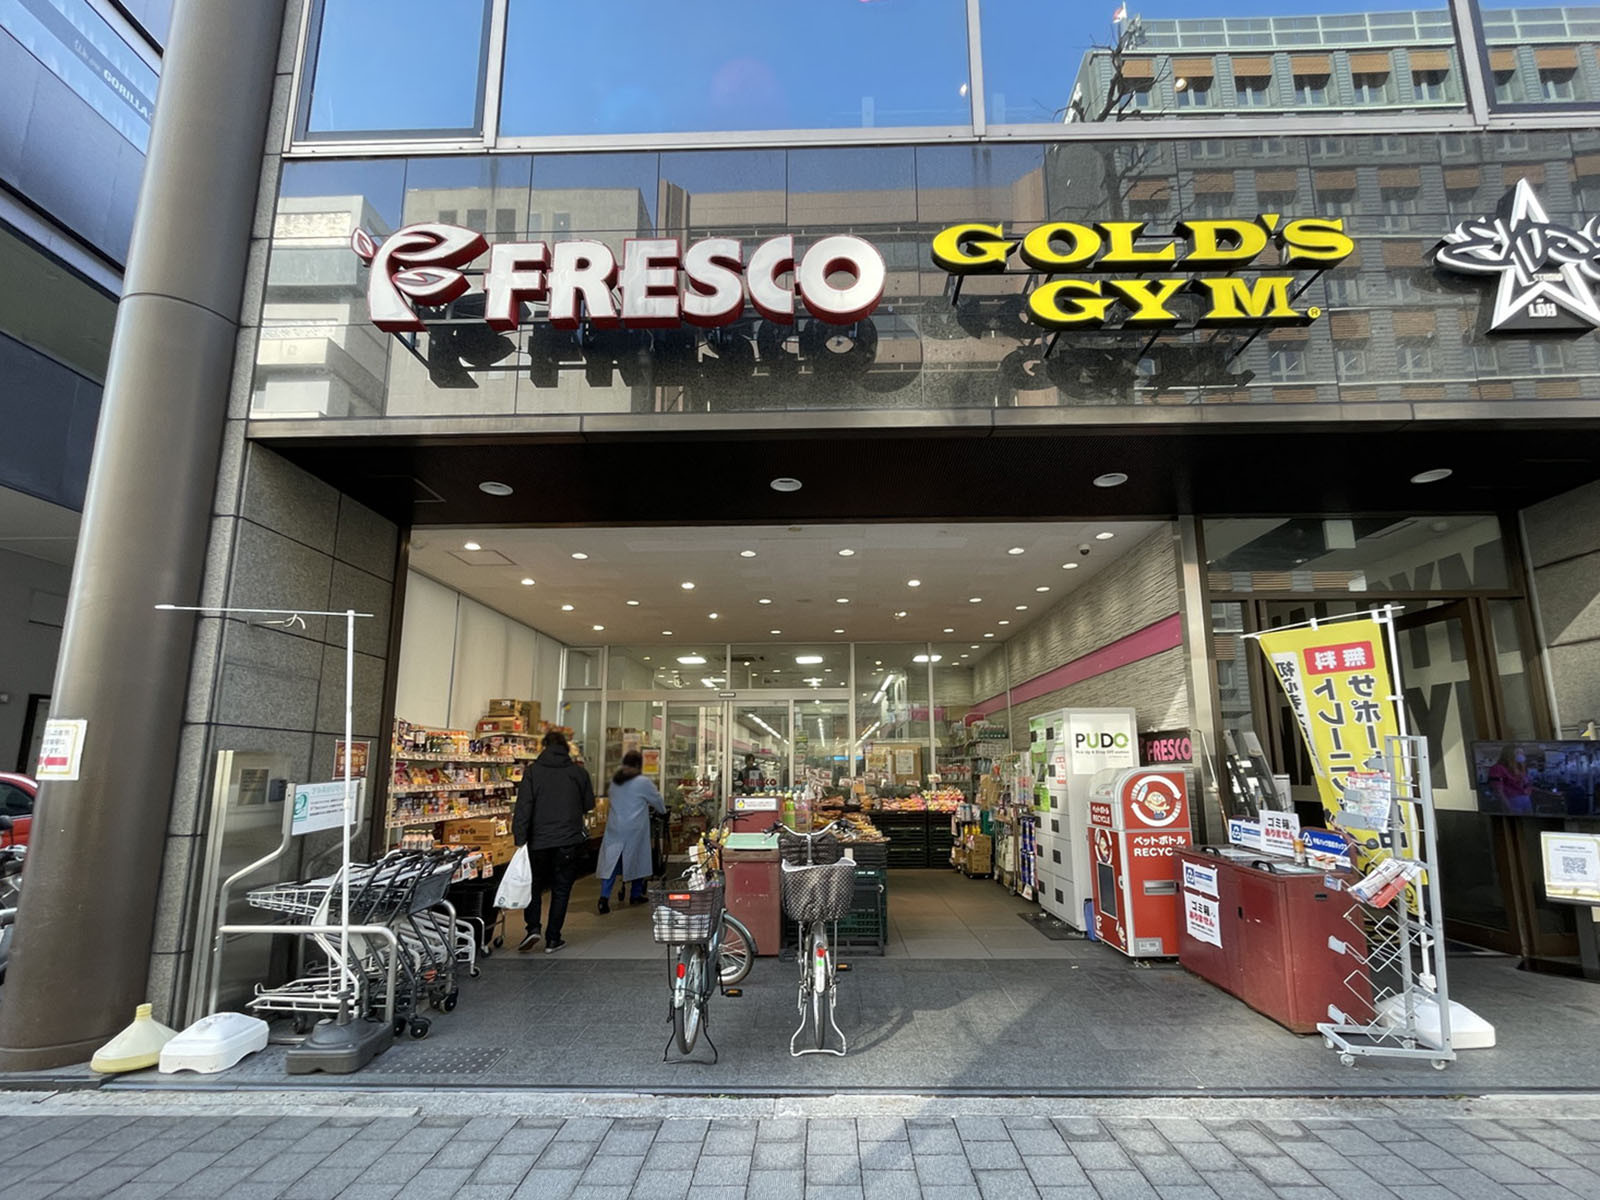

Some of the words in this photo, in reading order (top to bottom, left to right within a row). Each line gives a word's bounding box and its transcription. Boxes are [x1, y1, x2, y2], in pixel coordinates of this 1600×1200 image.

[102, 69, 150, 117] GORILLA
[931, 213, 1355, 271] GOLD'S
[483, 234, 887, 331] FRESCO
[1075, 732, 1129, 749] PUDO
[1147, 737, 1193, 762] FRESCO
[1133, 835, 1187, 846] ペットボトル
[1133, 847, 1174, 857] RECYC
